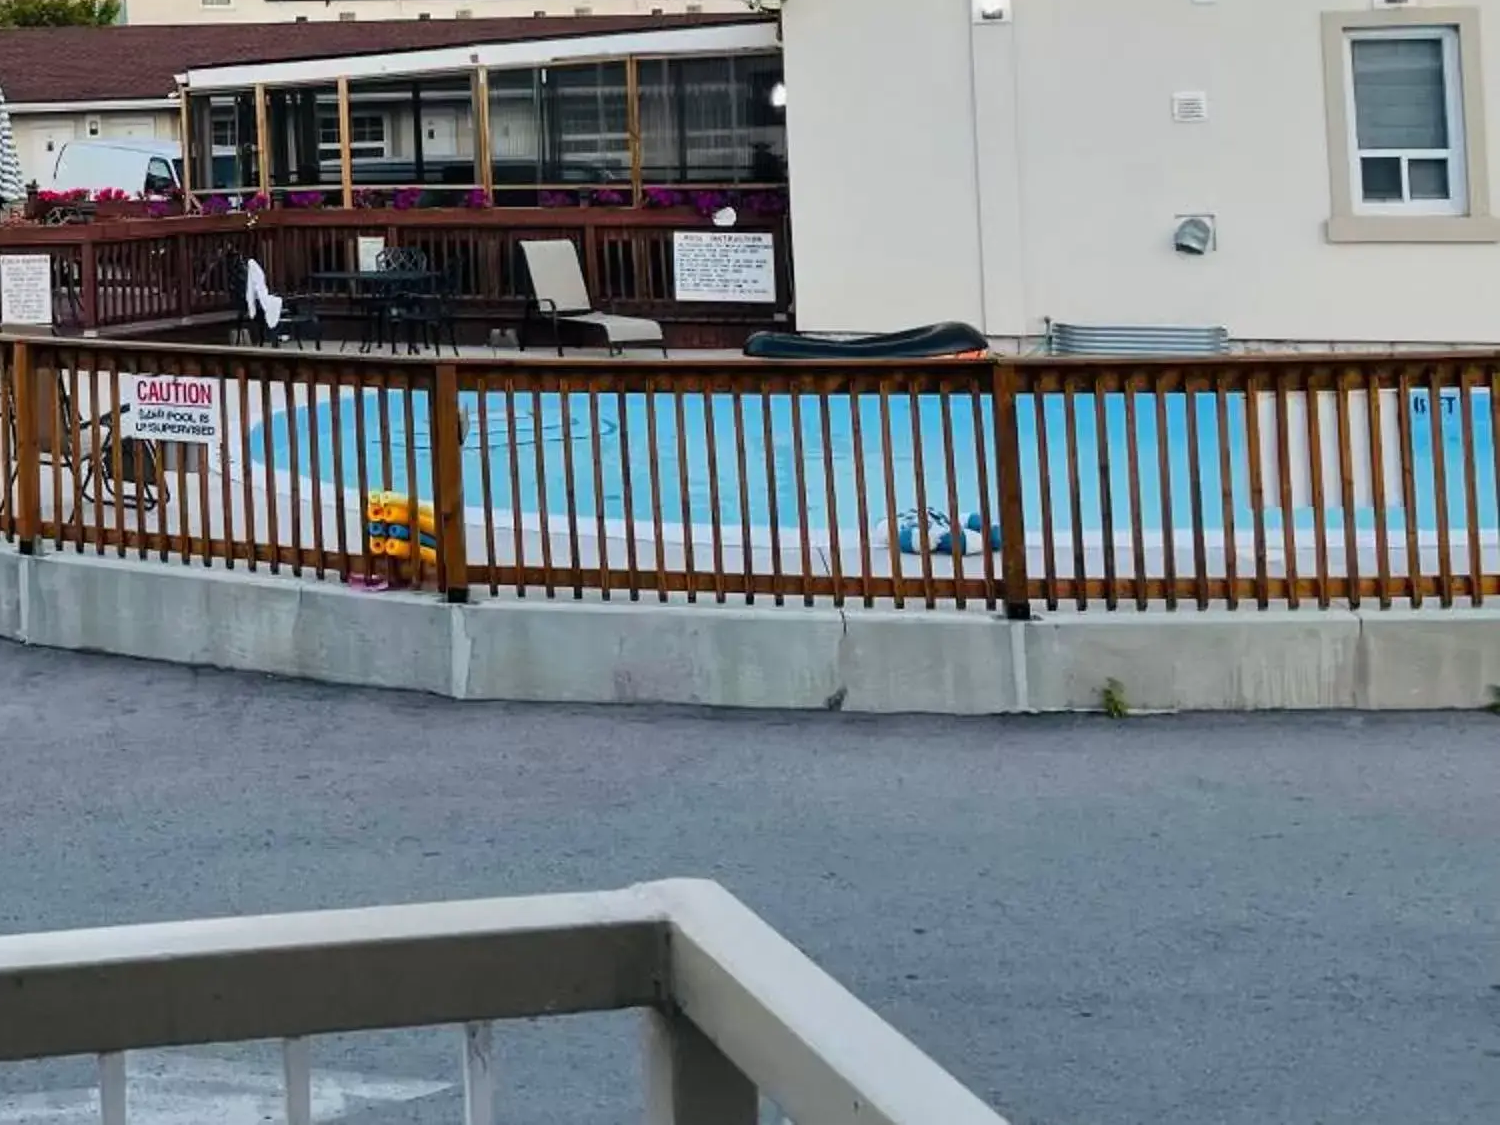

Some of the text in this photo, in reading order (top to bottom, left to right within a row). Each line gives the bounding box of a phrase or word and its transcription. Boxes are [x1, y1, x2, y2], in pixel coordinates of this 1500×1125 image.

[137, 380, 212, 404] CAUTION
[167, 410, 196, 423] POOL
[199, 413, 210, 424] IS
[136, 421, 215, 436] UNSUPERVISED
